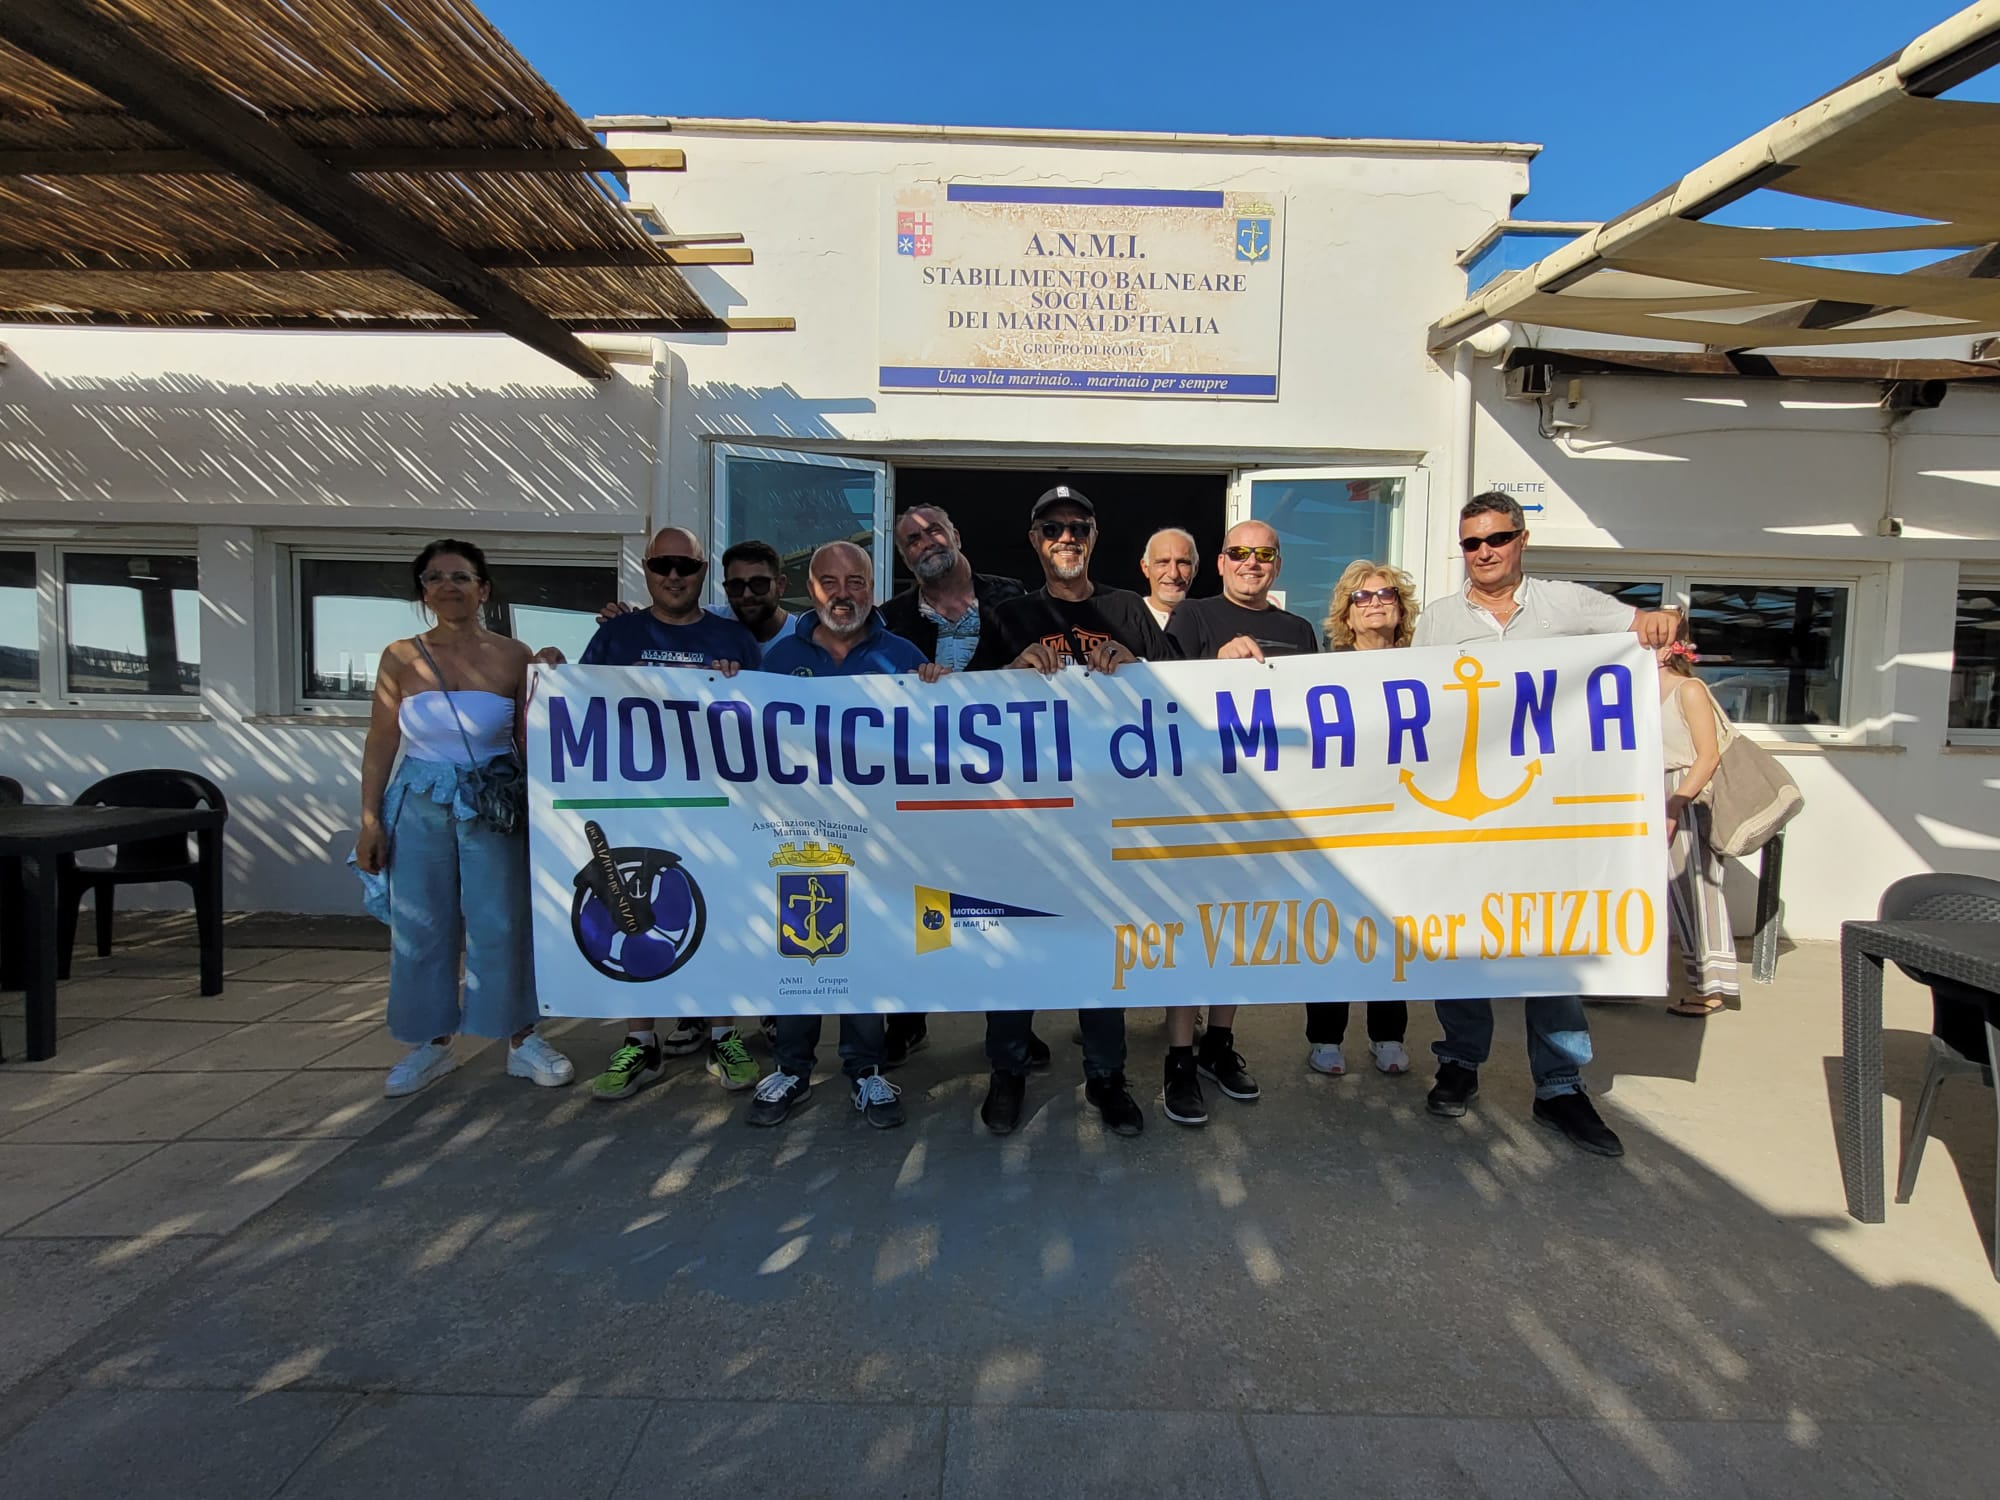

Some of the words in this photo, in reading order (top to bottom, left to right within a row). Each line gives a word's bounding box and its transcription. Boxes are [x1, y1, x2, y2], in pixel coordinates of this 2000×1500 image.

[1024, 232, 1146, 259] A.N.M.I.
[922, 266, 1108, 289] STABILIMENTO
[1115, 270, 1247, 292] BALNEARE
[1031, 290, 1138, 311] SOCIALE
[947, 310, 989, 329] DEI
[997, 312, 1105, 332] MARINAI
[1113, 314, 1220, 334] D'ITALIA
[1023, 343, 1080, 355] GRUPPO
[1084, 345, 1098, 355] DI
[1103, 345, 1144, 356] ROMA
[938, 369, 966, 384] Una
[970, 370, 1005, 385] volta
[1008, 372, 1082, 387] marinaio...
[1087, 374, 1149, 388] marinaio
[1151, 379, 1177, 392] per
[1178, 380, 1229, 393] sempre
[1491, 482, 1545, 493] TOILETTE
[547, 695, 1075, 786] MOTOCICLISTI
[1109, 698, 1184, 779] di
[752, 818, 816, 831] Associazione
[818, 819, 869, 834] Nazionale
[773, 827, 810, 838] Marinai
[813, 828, 848, 839] d'Italia
[953, 908, 1005, 916] MOTOCICLISTI
[953, 920, 961, 928] di
[1112, 920, 1185, 990] per
[1197, 897, 1341, 969] VIZIO
[1353, 914, 1378, 964] o
[1392, 911, 1467, 982] per
[1479, 887, 1656, 960] SFIZIO
[779, 976, 803, 985] ANMI
[817, 976, 849, 986] Gruppo
[813, 987, 826, 995] del
[827, 986, 849, 994] Friuli
